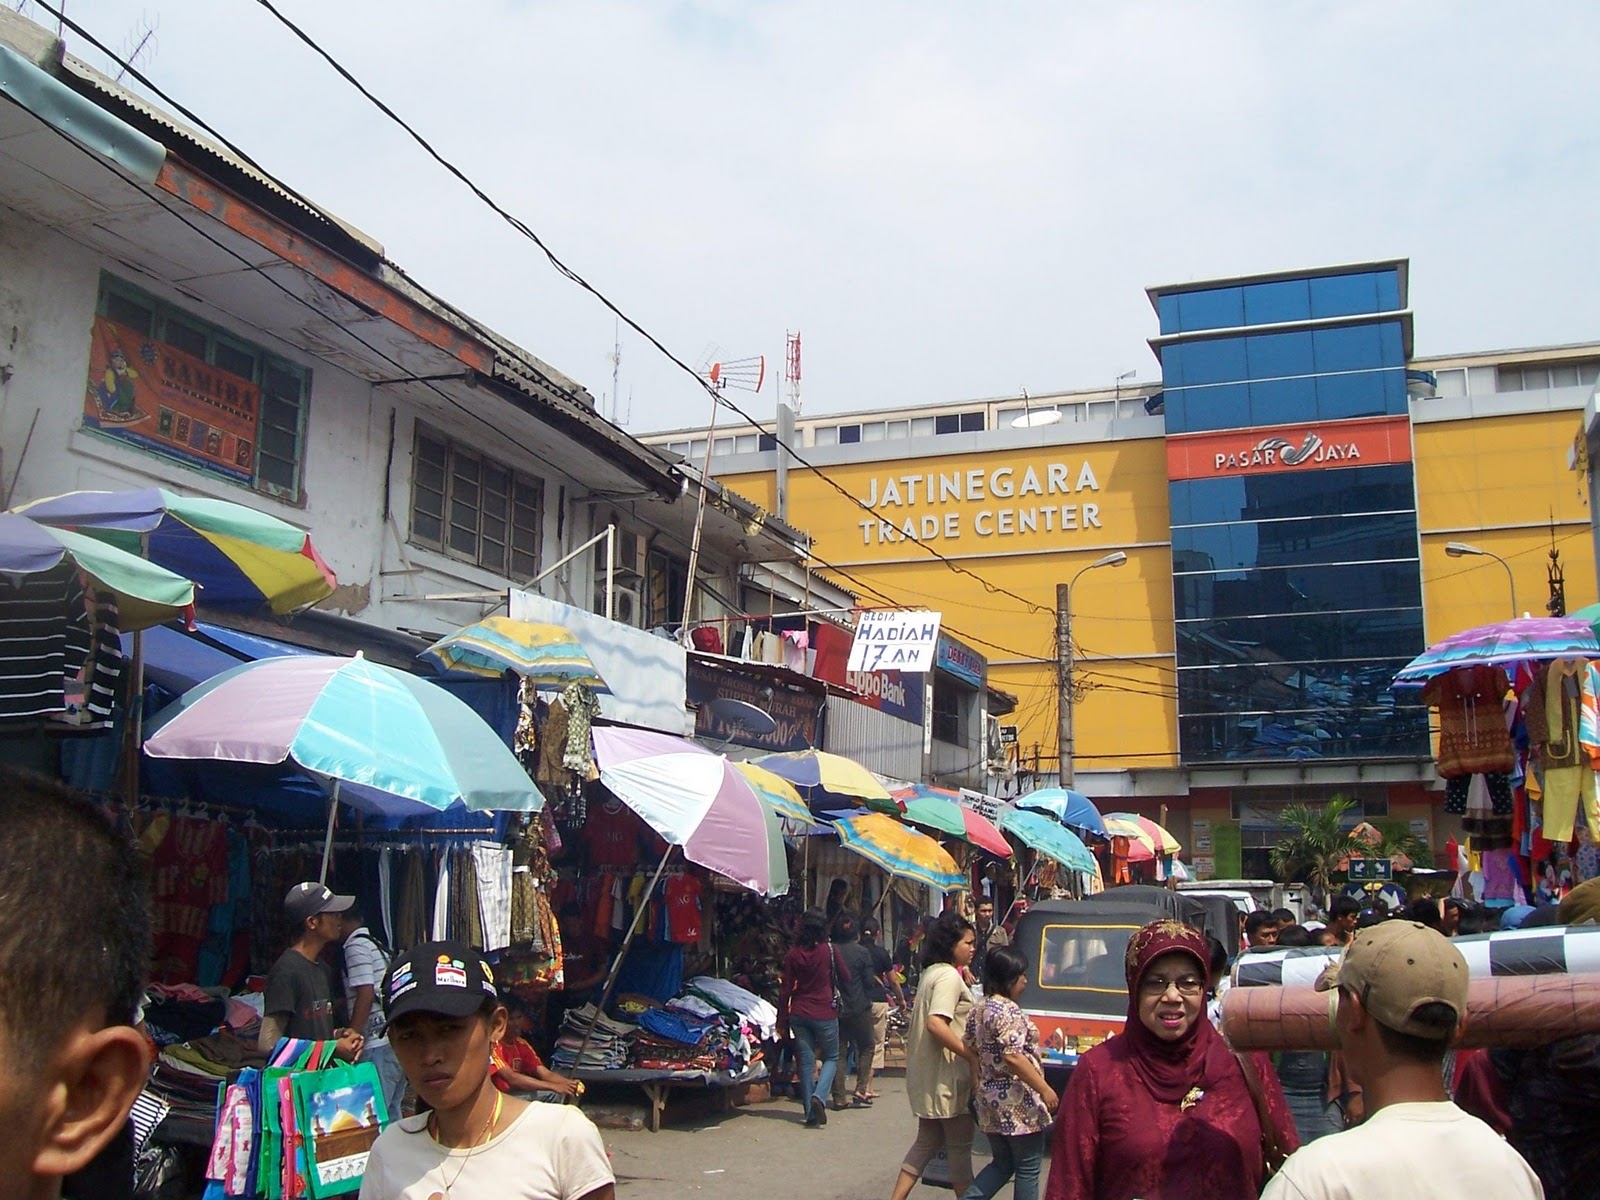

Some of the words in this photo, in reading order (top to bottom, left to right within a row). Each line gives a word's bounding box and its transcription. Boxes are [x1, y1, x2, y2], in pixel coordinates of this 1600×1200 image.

[1215, 449, 1276, 469] PASAR
[1314, 443, 1361, 462] JAYA
[858, 460, 1101, 509] JATINEGARA
[858, 513, 961, 545] TRADE
[974, 503, 1102, 536] CENTER
[720, 676, 755, 693] GROSIR
[761, 699, 796, 717] MURAH
